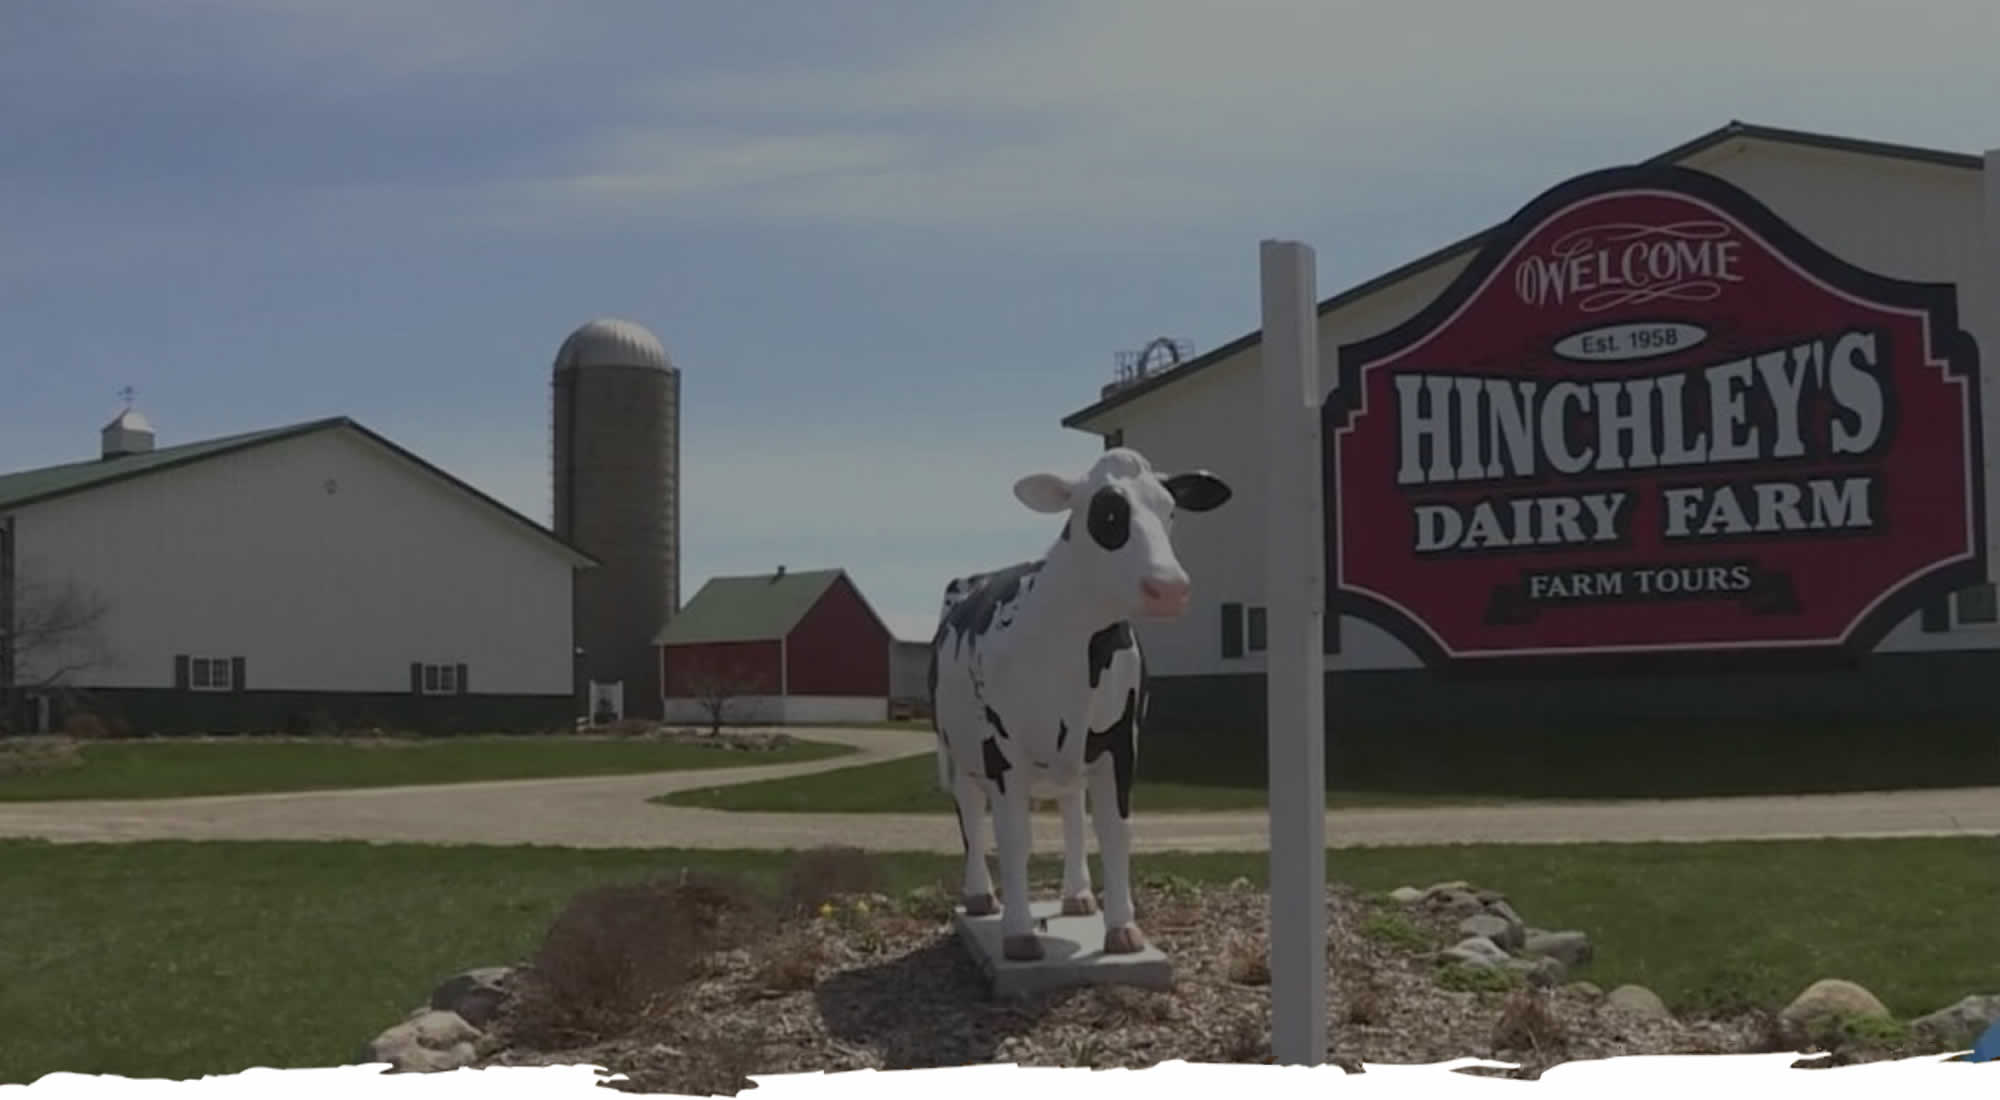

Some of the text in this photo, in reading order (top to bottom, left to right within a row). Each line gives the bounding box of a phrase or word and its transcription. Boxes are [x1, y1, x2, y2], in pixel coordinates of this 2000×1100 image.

[1514, 222, 1745, 312] WELCOME
[1580, 327, 1679, 355] Est. 1958
[1394, 331, 1885, 485] HINCHLEY'S
[1414, 477, 1873, 553] DAIRY FARM
[1529, 565, 1752, 599] FARM TOURS
